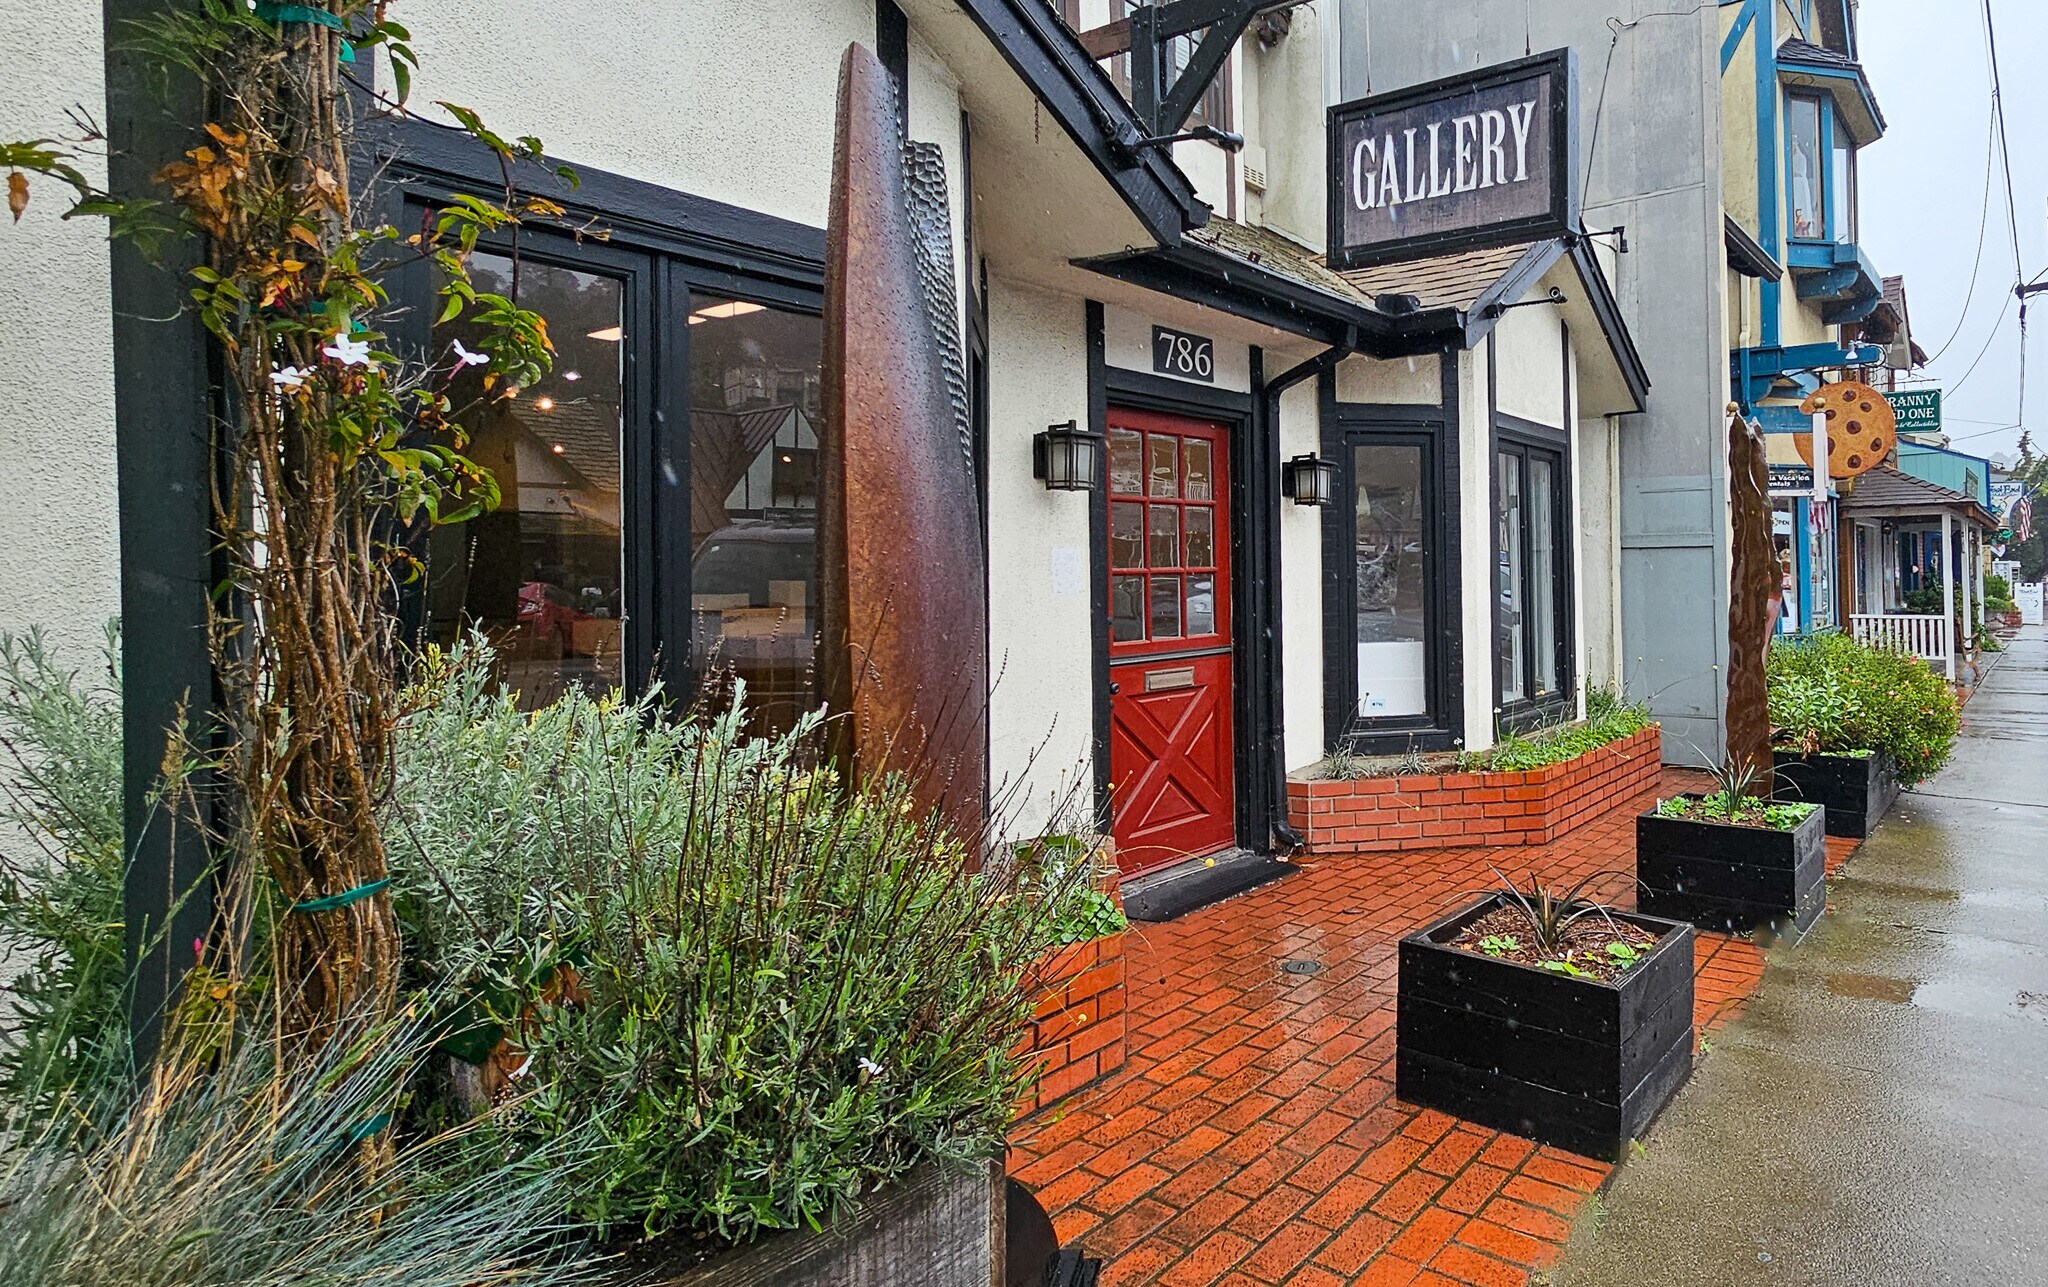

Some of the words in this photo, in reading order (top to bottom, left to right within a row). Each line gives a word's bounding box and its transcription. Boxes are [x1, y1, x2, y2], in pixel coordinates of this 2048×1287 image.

[1353, 100, 1536, 210] GALLERY
[1158, 332, 1212, 376] 786
[1884, 392, 1936, 407] RANNY
[1908, 407, 1935, 419] ONE
